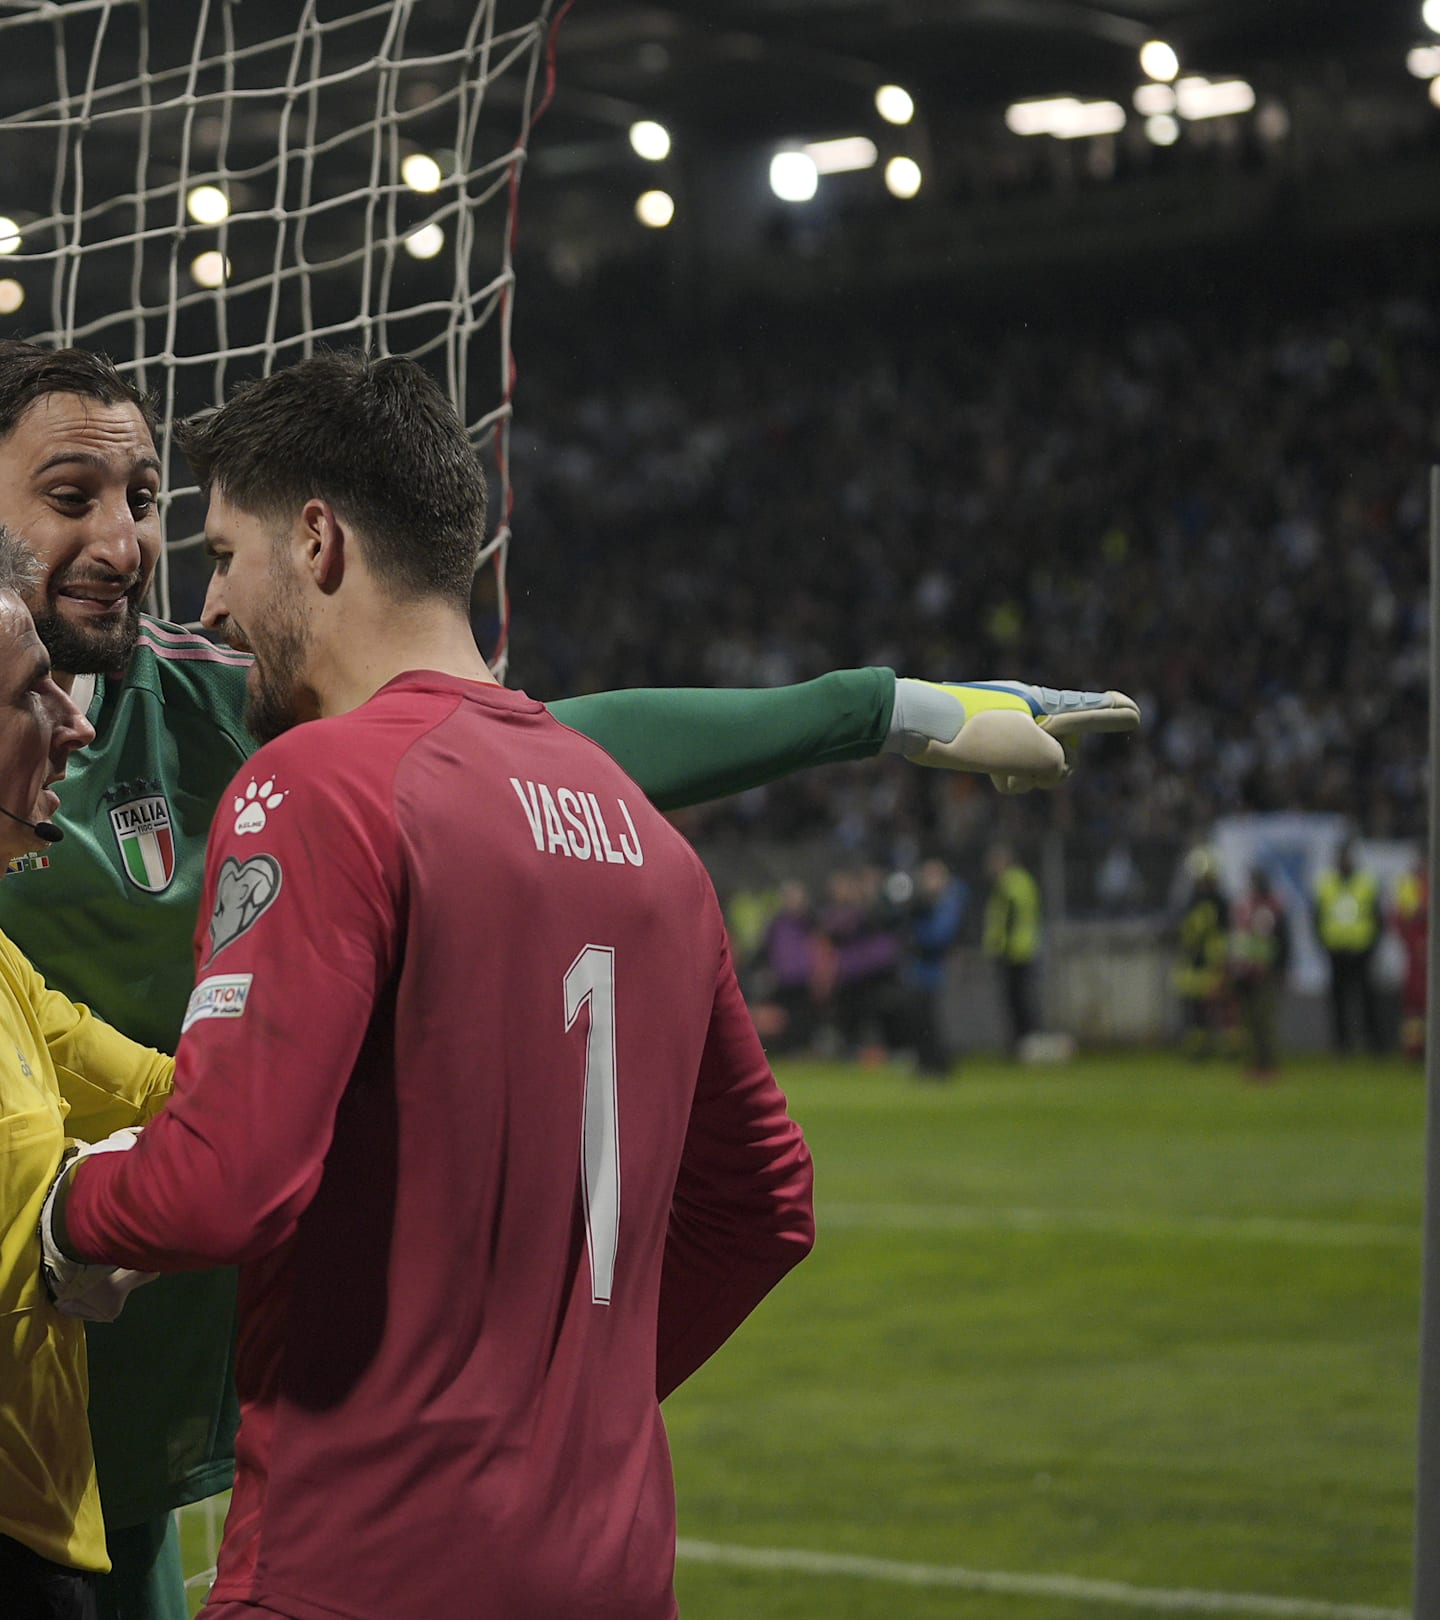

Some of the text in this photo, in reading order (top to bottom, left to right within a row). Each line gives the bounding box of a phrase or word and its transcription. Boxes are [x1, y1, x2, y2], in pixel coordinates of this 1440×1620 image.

[114, 801, 166, 830] ITALIA
[509, 777, 644, 867] VASILJ
[563, 943, 621, 1305] 1
